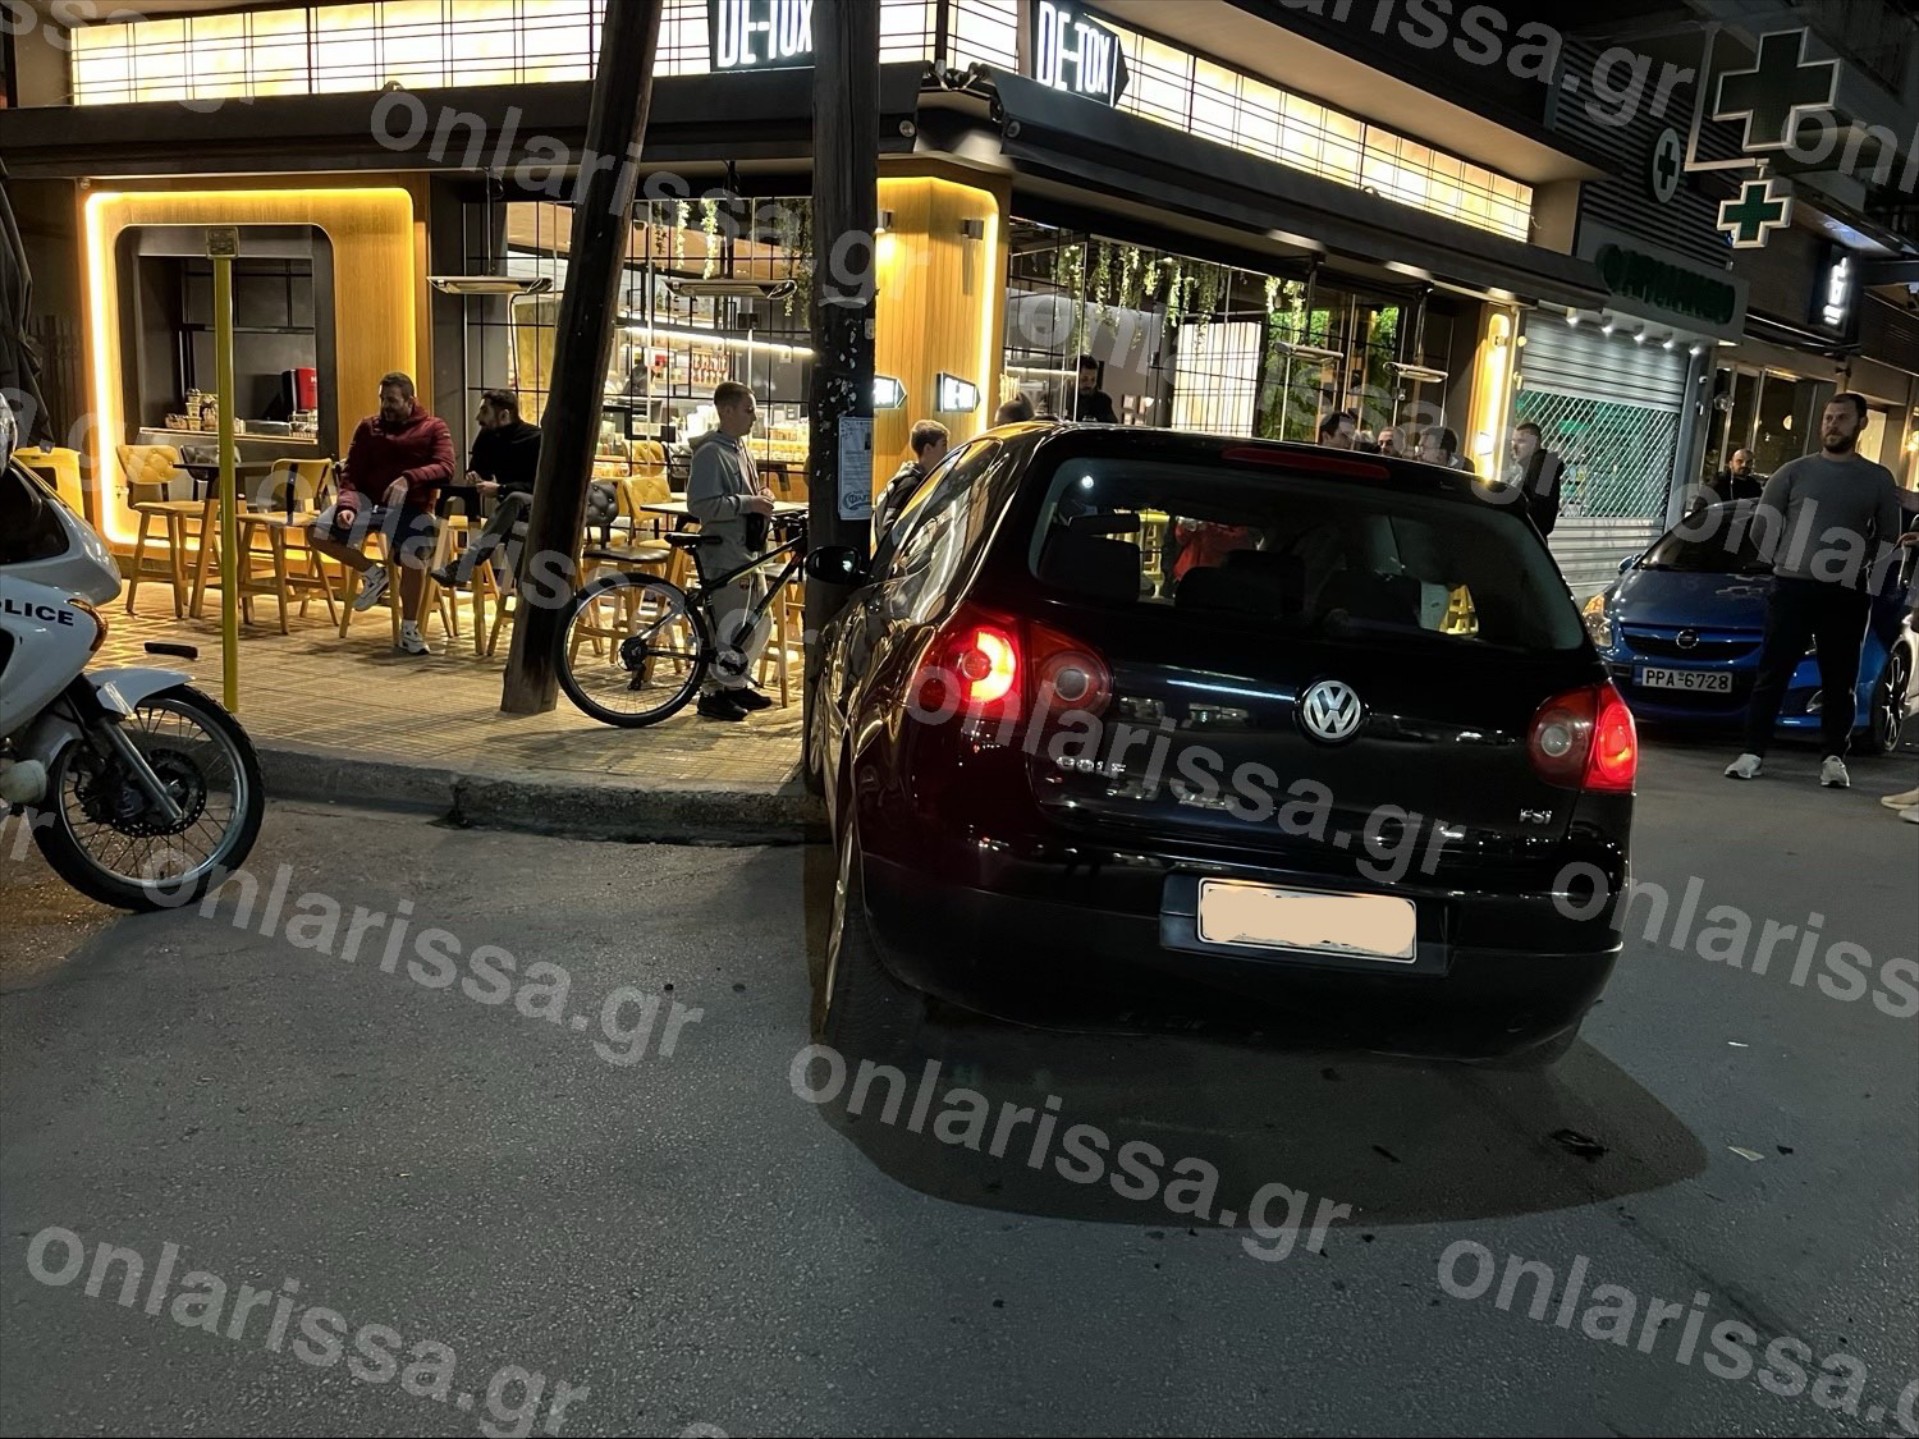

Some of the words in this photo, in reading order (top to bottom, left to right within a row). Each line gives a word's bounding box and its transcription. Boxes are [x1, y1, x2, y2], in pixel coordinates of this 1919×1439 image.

[717, 0, 813, 67] DE-TOX
[1036, 1, 1111, 94] DE-TOX
[0, 599, 74, 627] LICE
